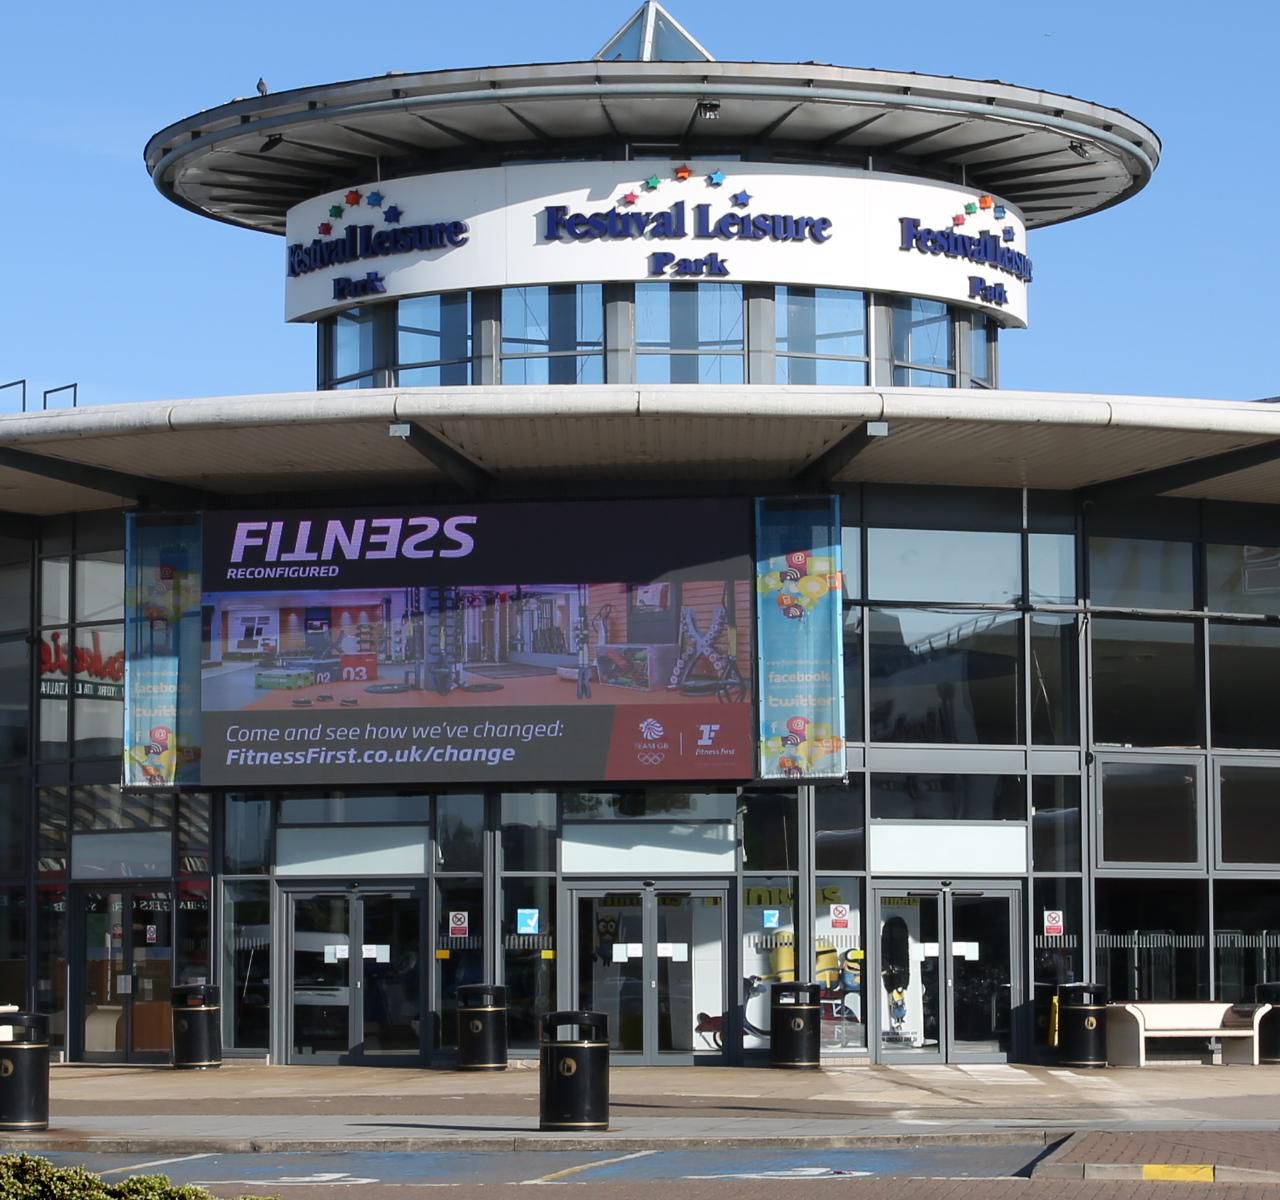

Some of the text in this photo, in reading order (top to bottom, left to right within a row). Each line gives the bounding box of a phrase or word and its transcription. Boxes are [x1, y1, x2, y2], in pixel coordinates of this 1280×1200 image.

[544, 200, 833, 244] Festival Leisure
[359, 220, 471, 259] Leisure
[898, 216, 991, 266] Festival
[651, 251, 730, 277] Park
[332, 271, 387, 300] Park
[968, 275, 1009, 306] Park
[226, 565, 340, 579] RECONFIGURED
[767, 671, 831, 683] facebook
[225, 720, 565, 742] Come and see how we've changed:
[225, 745, 517, 766] FitnessFirst.co.uk/change
